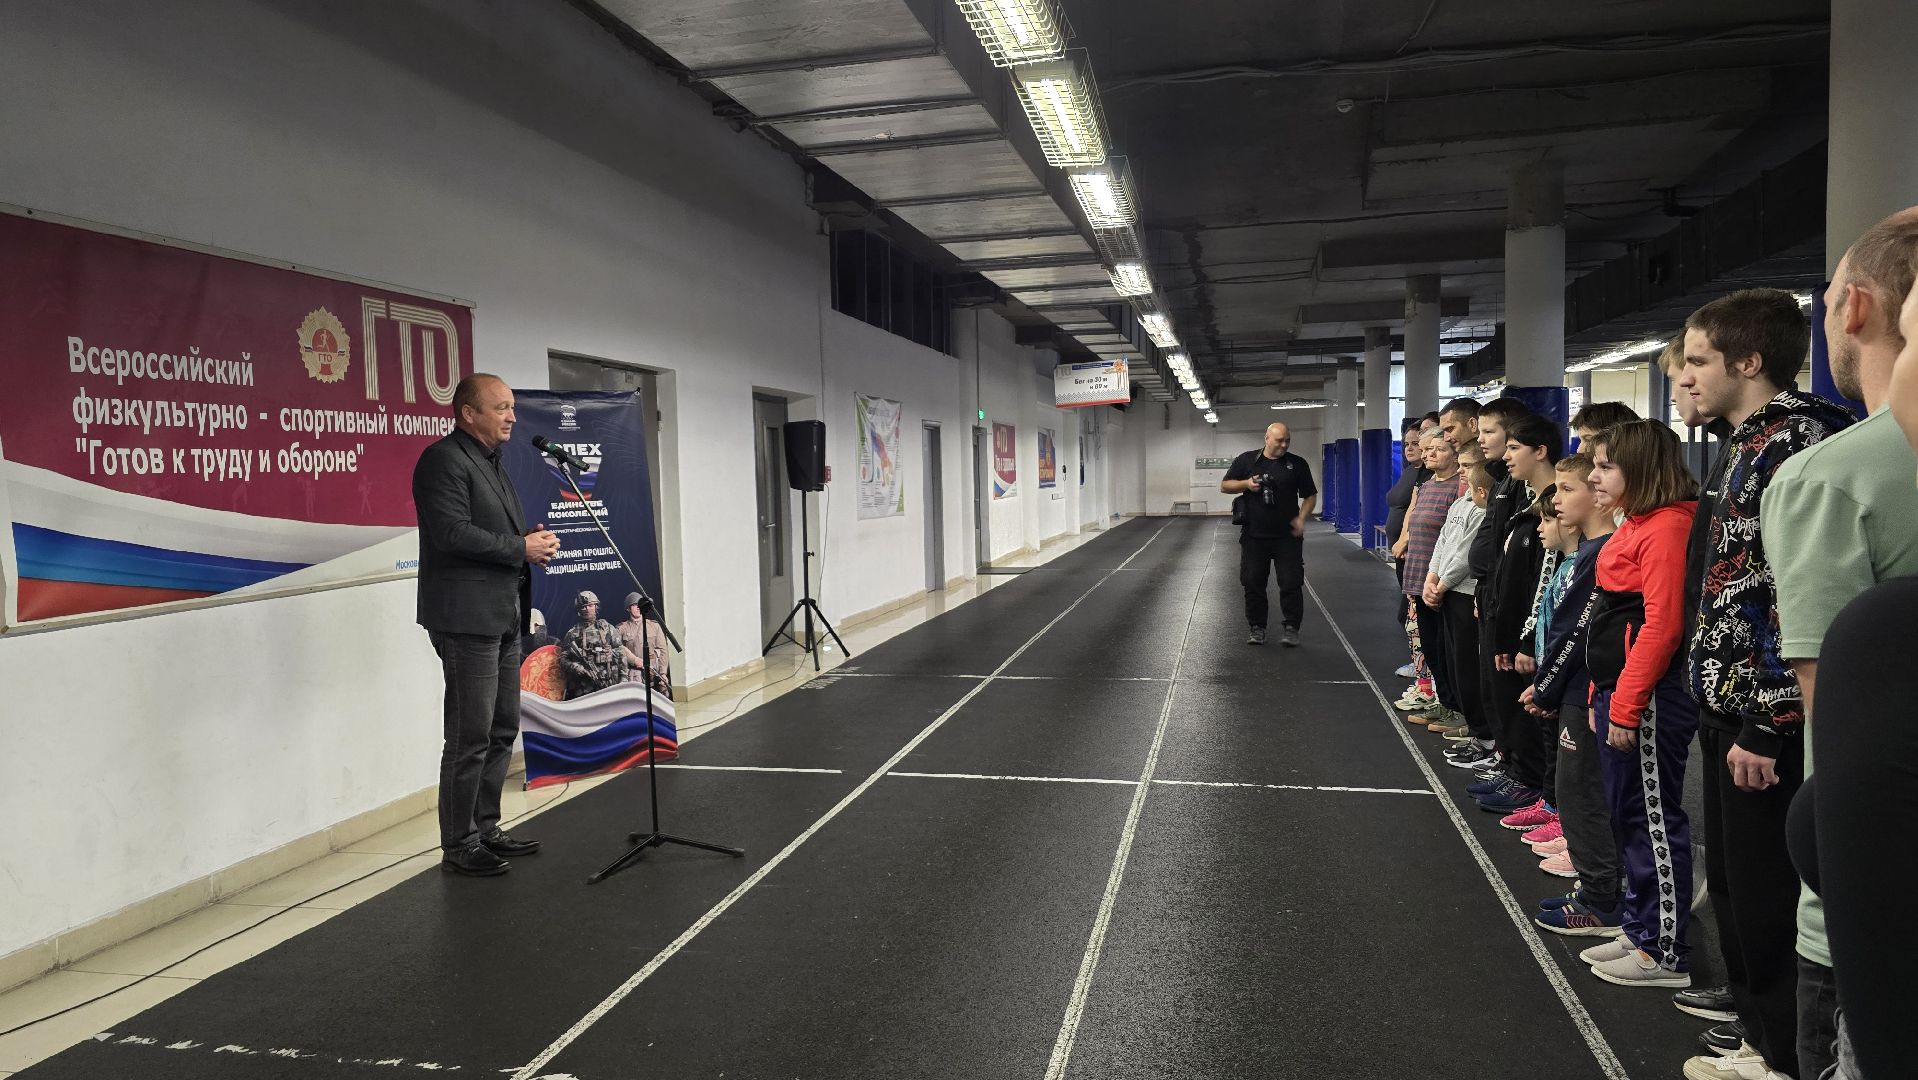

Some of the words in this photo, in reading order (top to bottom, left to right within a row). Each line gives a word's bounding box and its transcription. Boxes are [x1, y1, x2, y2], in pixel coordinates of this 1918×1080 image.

[68, 336, 254, 387] Всероссийский
[318, 354, 333, 363] ГТО
[361, 296, 460, 406] ГТО
[73, 387, 248, 437] физкультурно
[280, 405, 388, 440] спортивный
[394, 414, 456, 437] комплек
[76, 437, 165, 476] "Готов
[173, 449, 186, 474] к
[191, 448, 252, 482] труду
[259, 449, 271, 473] и
[277, 442, 364, 481] обороне"
[395, 559, 420, 570] Москов
[583, 547, 616, 558] ПРОШЛО
[545, 562, 588, 575] ЗАЩИЩАЕМ
[589, 560, 622, 571] БУДУЩЕЕ
[1576, 601, 1593, 628] SCHOOL
[1557, 640, 1576, 665] EXPLORE
